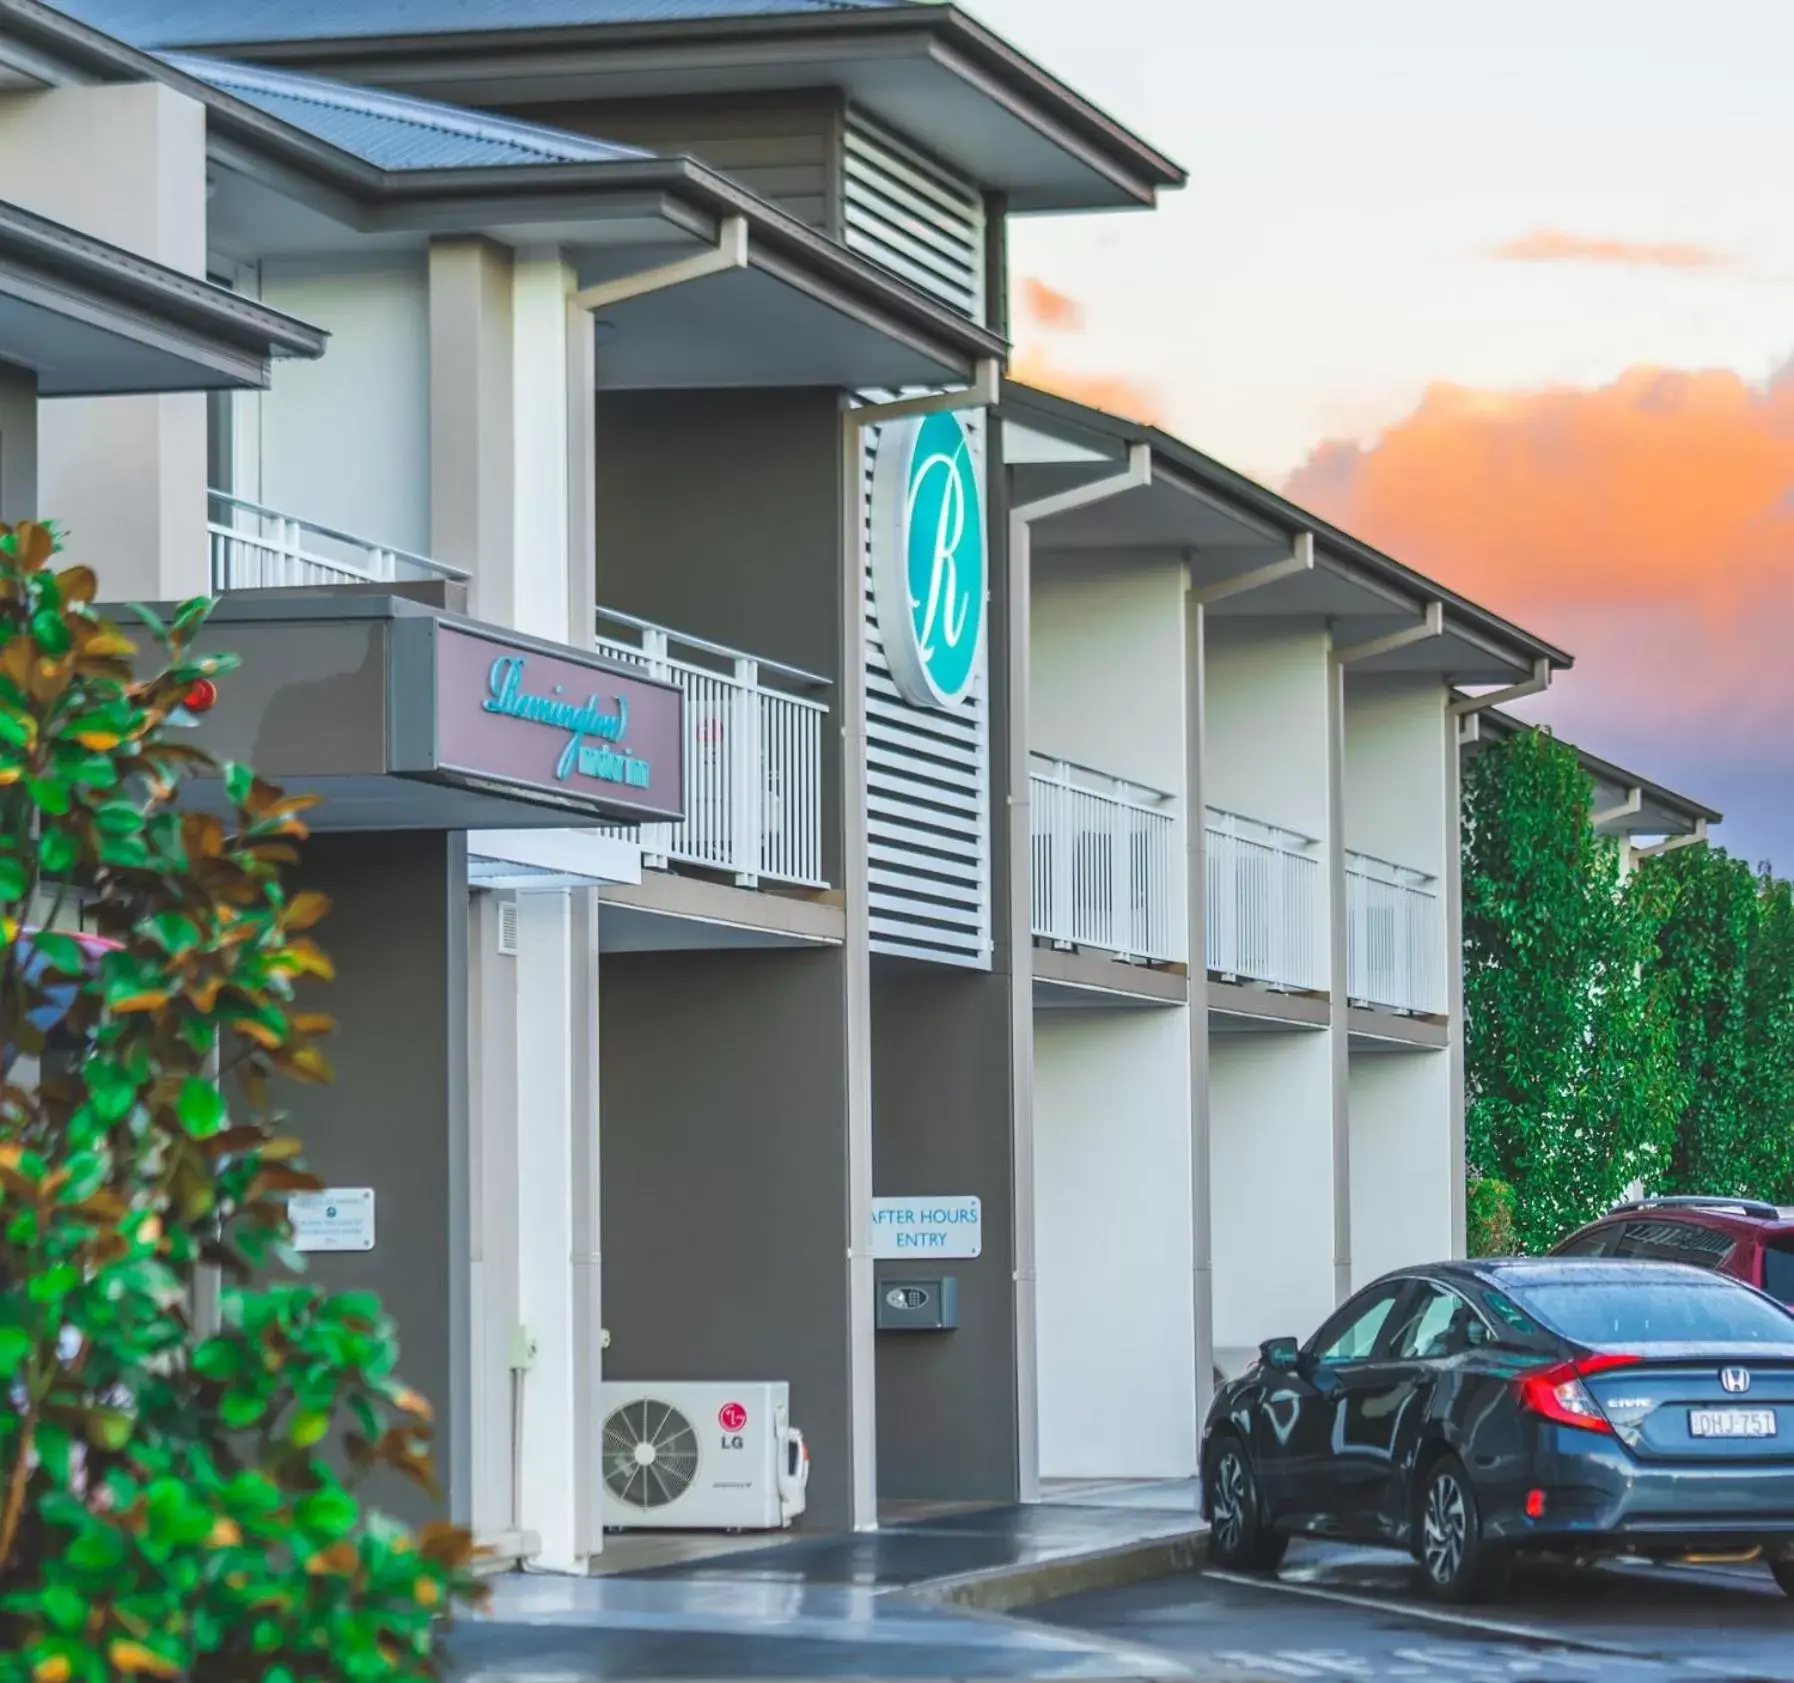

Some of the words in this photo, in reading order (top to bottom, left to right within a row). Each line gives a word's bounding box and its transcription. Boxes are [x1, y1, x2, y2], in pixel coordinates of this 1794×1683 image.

[906, 438, 969, 663] R
[920, 1209, 978, 1224] HOURS
[896, 1232, 947, 1247] ENTRY
[721, 1436, 743, 1449] LG
